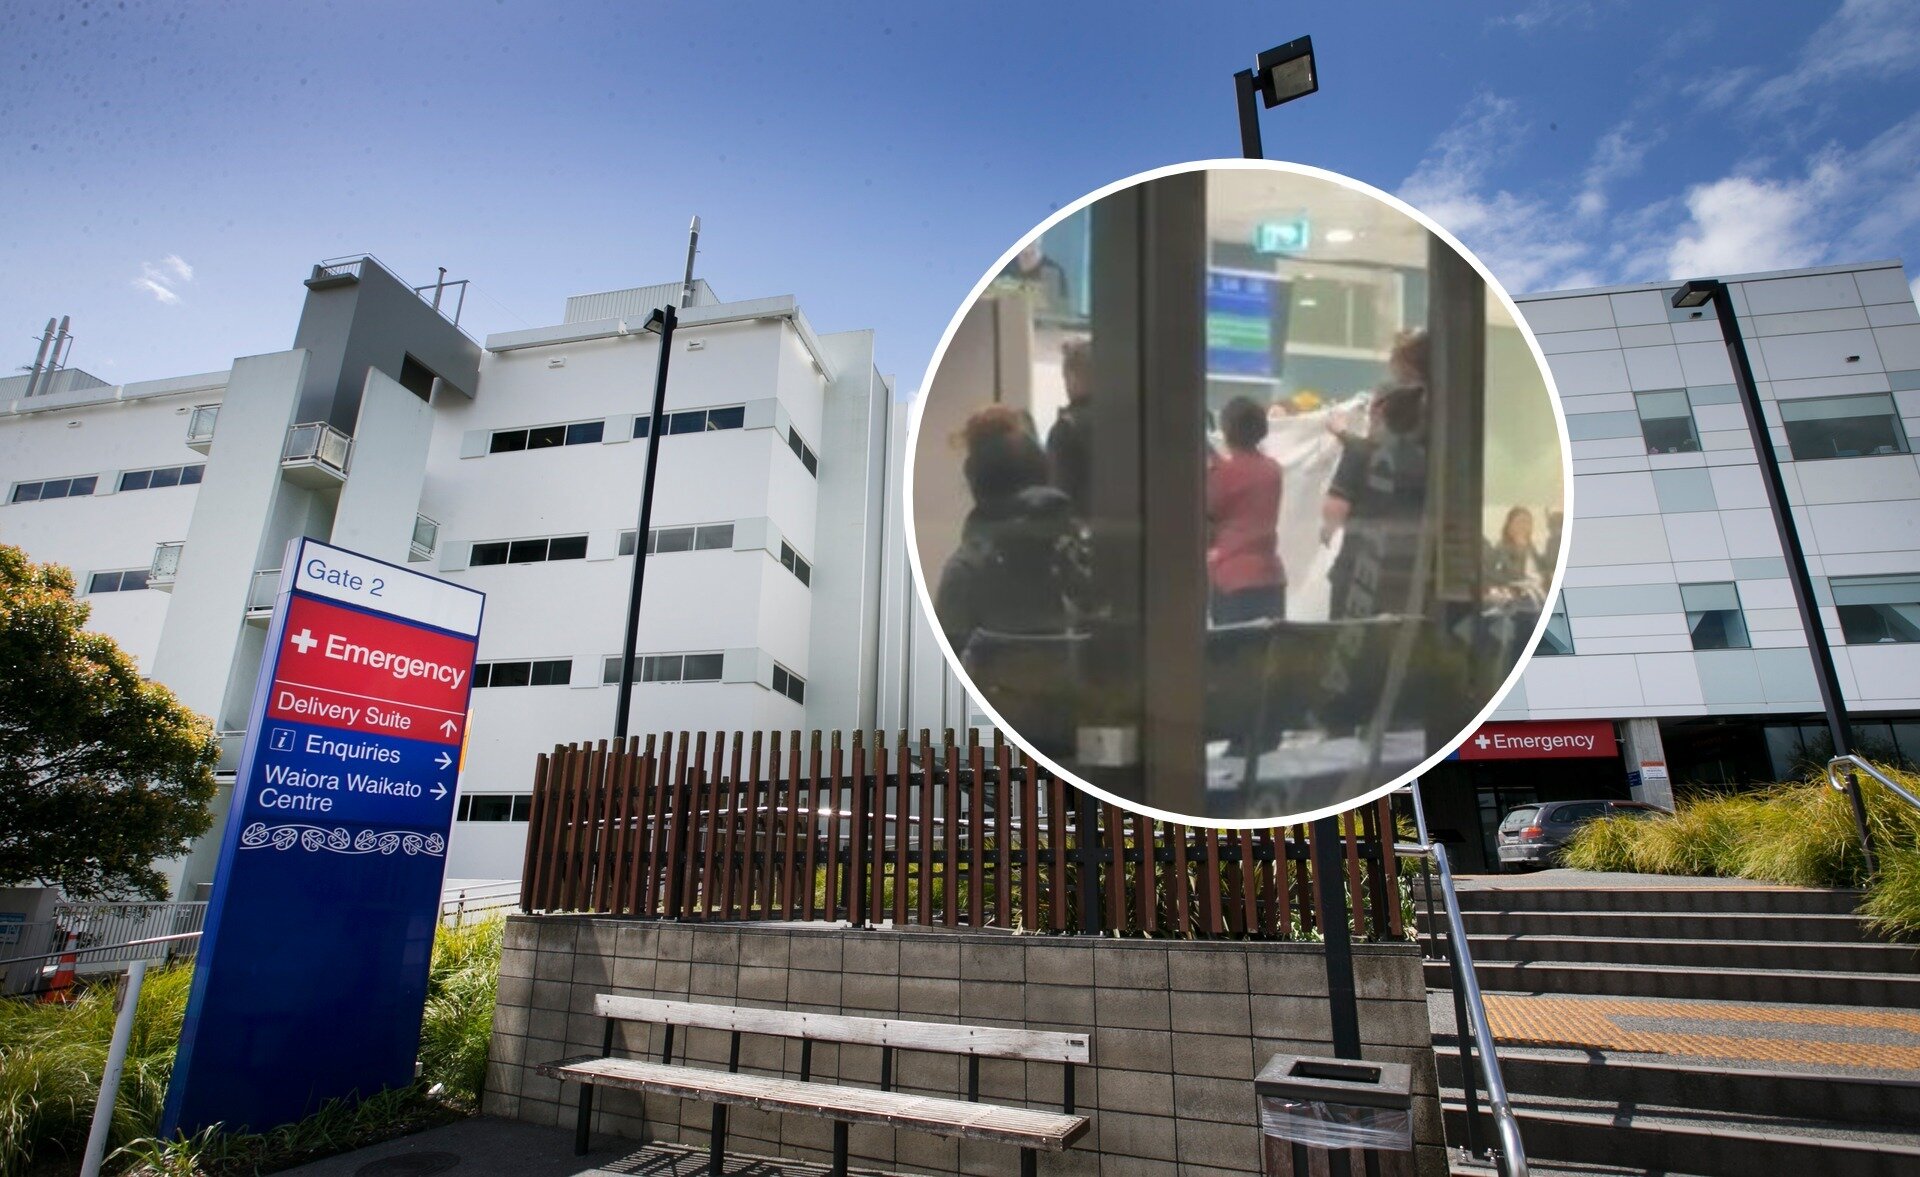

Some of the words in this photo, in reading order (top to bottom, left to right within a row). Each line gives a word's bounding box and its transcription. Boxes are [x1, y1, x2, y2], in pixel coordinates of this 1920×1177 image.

[306, 559, 363, 591] Gate
[370, 578, 385, 597] 2
[325, 634, 466, 689] Emergency
[277, 691, 360, 725] Delivery
[365, 706, 411, 730] Suite
[305, 734, 401, 764] Enquiries
[1494, 734, 1595, 751] Emergency
[265, 764, 339, 790] Waiora
[347, 773, 422, 798] Waikato
[259, 788, 333, 812] Centre
